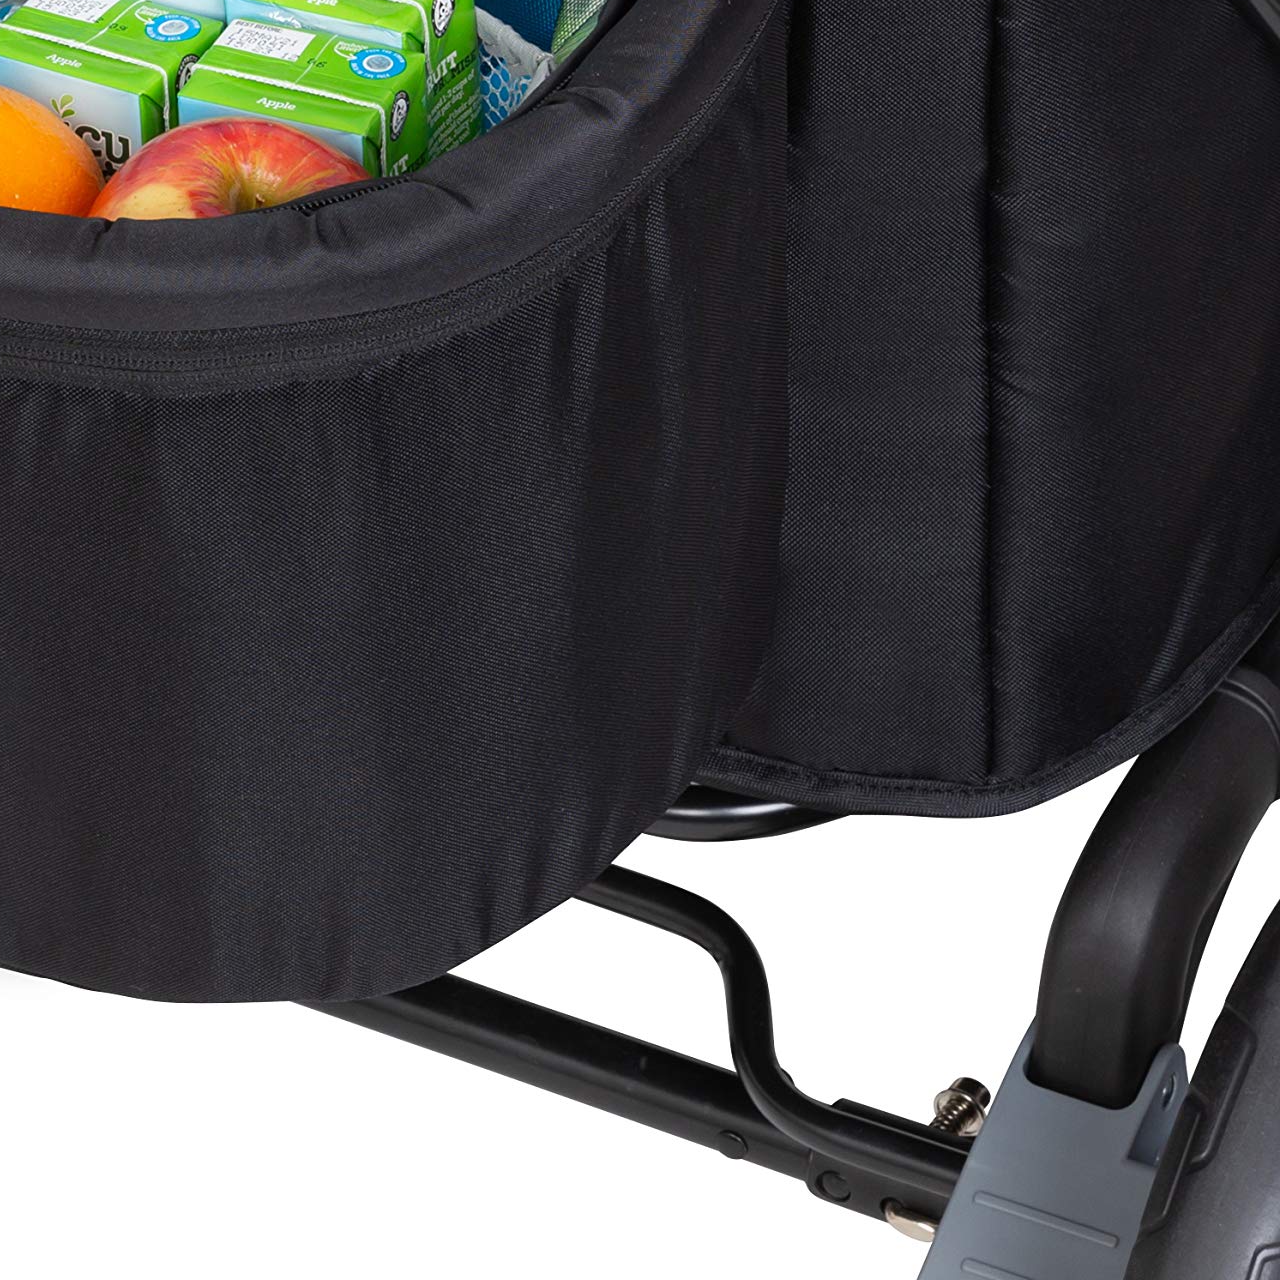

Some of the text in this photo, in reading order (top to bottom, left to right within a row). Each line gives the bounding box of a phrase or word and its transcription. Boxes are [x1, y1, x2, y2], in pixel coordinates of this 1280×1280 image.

[46, 52, 83, 69] Apple
[427, 50, 458, 96] RUIT
[256, 96, 296, 112] Apple
